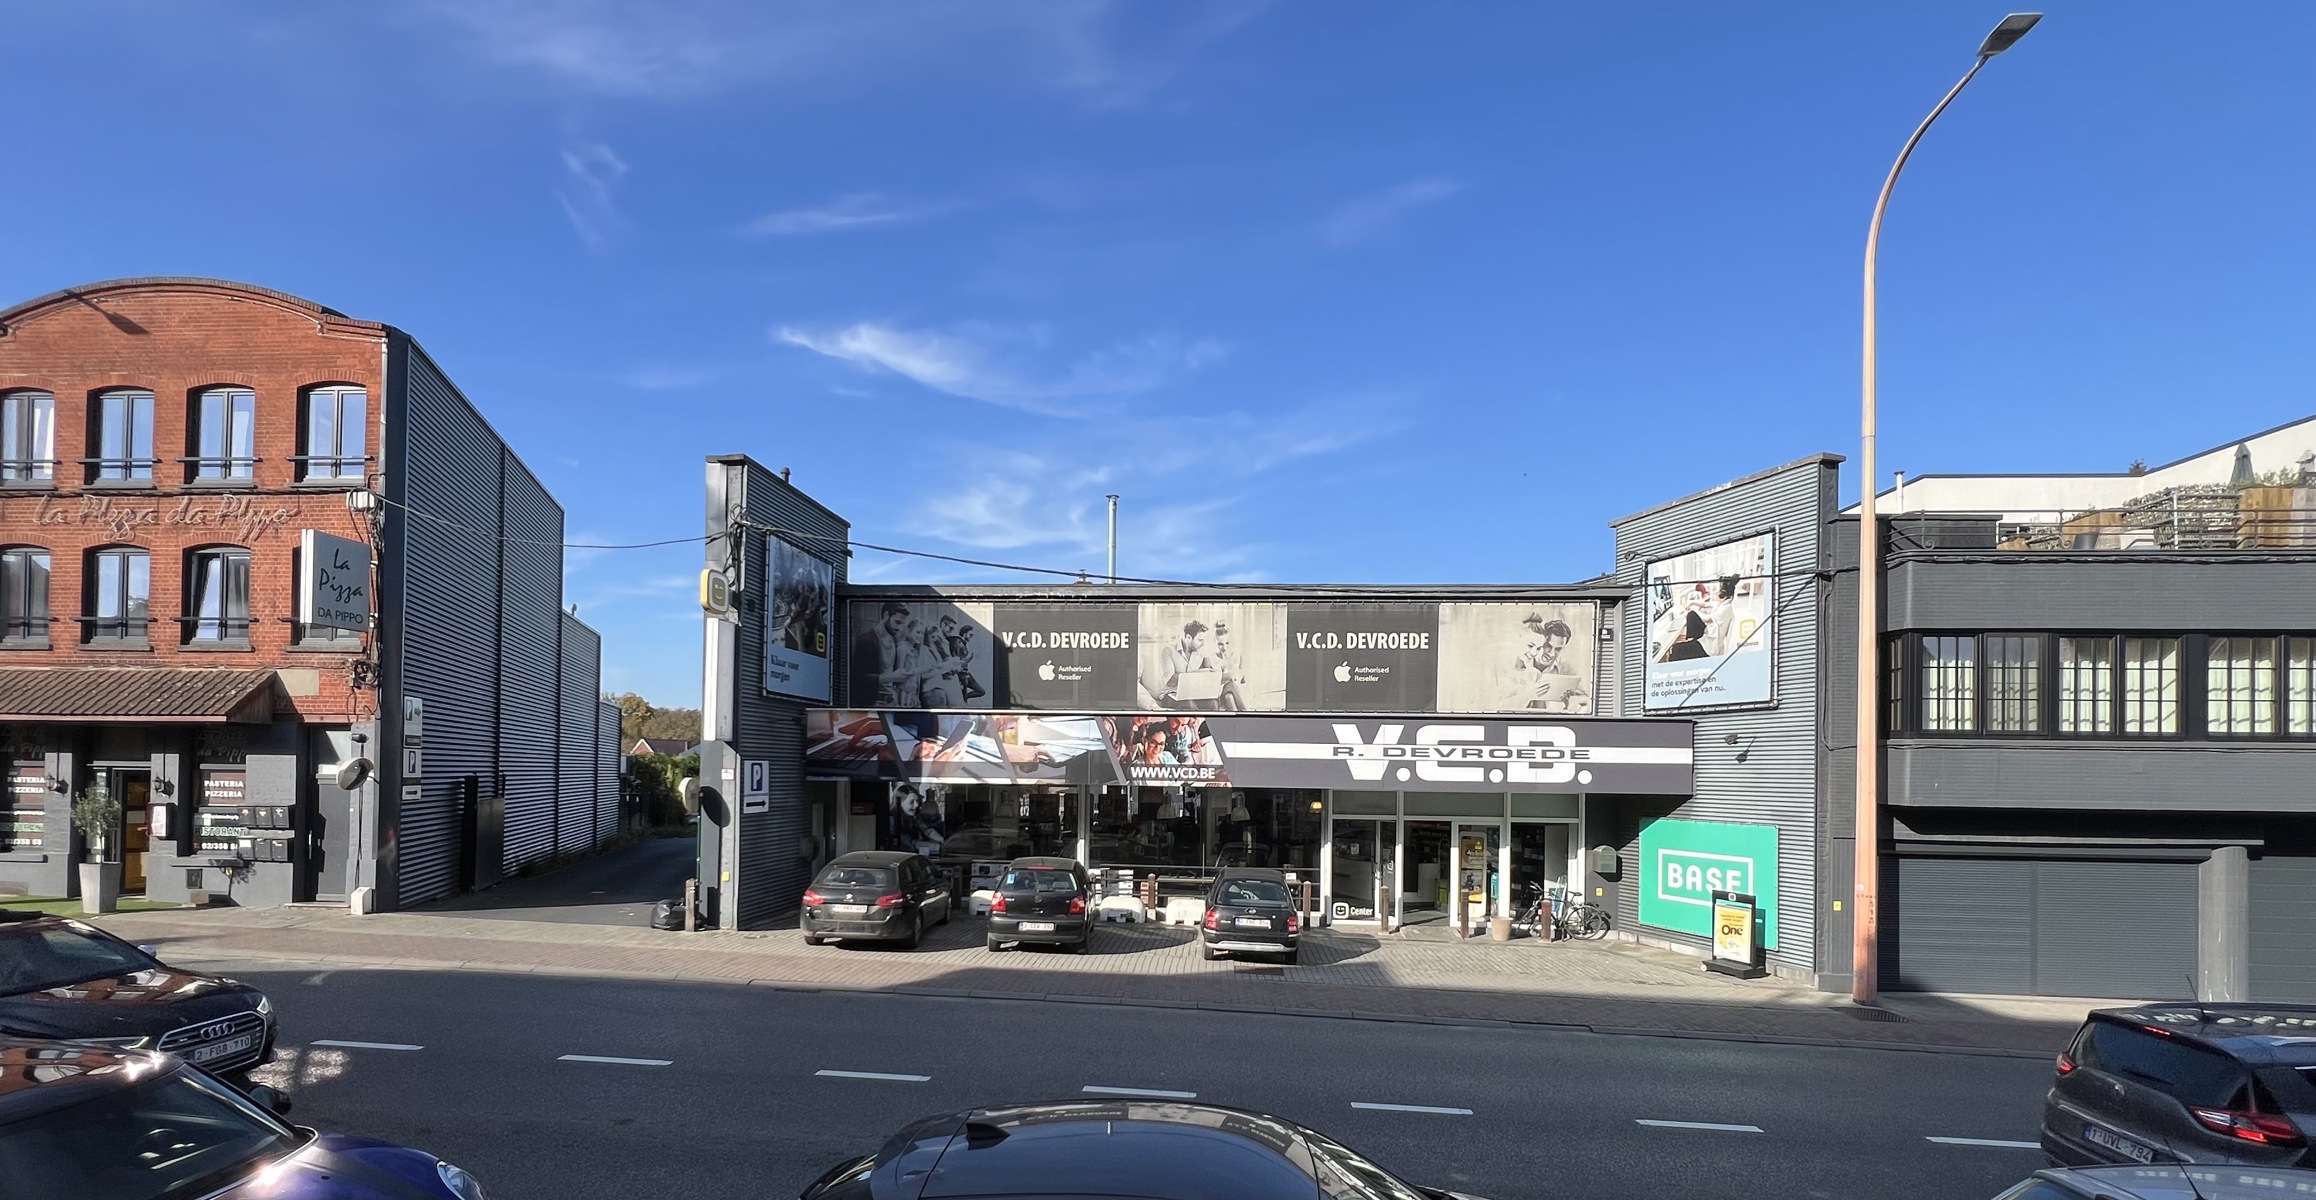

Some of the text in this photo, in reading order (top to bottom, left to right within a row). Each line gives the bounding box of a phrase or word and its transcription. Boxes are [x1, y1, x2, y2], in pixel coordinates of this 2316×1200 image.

[333, 548, 351, 571] La
[319, 567, 363, 604] Pizza
[317, 606, 364, 624] DA PIPPO
[1002, 631, 1130, 649] V.C.D. DEVROEDE
[1296, 632, 1429, 649] V.C.D. DEVROEDE
[1058, 665, 1092, 673] Authorised
[1354, 666, 1390, 674] Authorised
[1058, 673, 1082, 681] Reseller
[1651, 689, 1660, 697] de
[1332, 746, 1590, 760] R. DEVROEDE
[1130, 766, 1216, 779] WWW.VCD.BE
[204, 780, 244, 788] PASTERIA
[205, 790, 243, 798] PIZZERIA
[1667, 862, 1742, 894] BASE
[1350, 906, 1374, 916] Center
[1721, 924, 1744, 936] One
